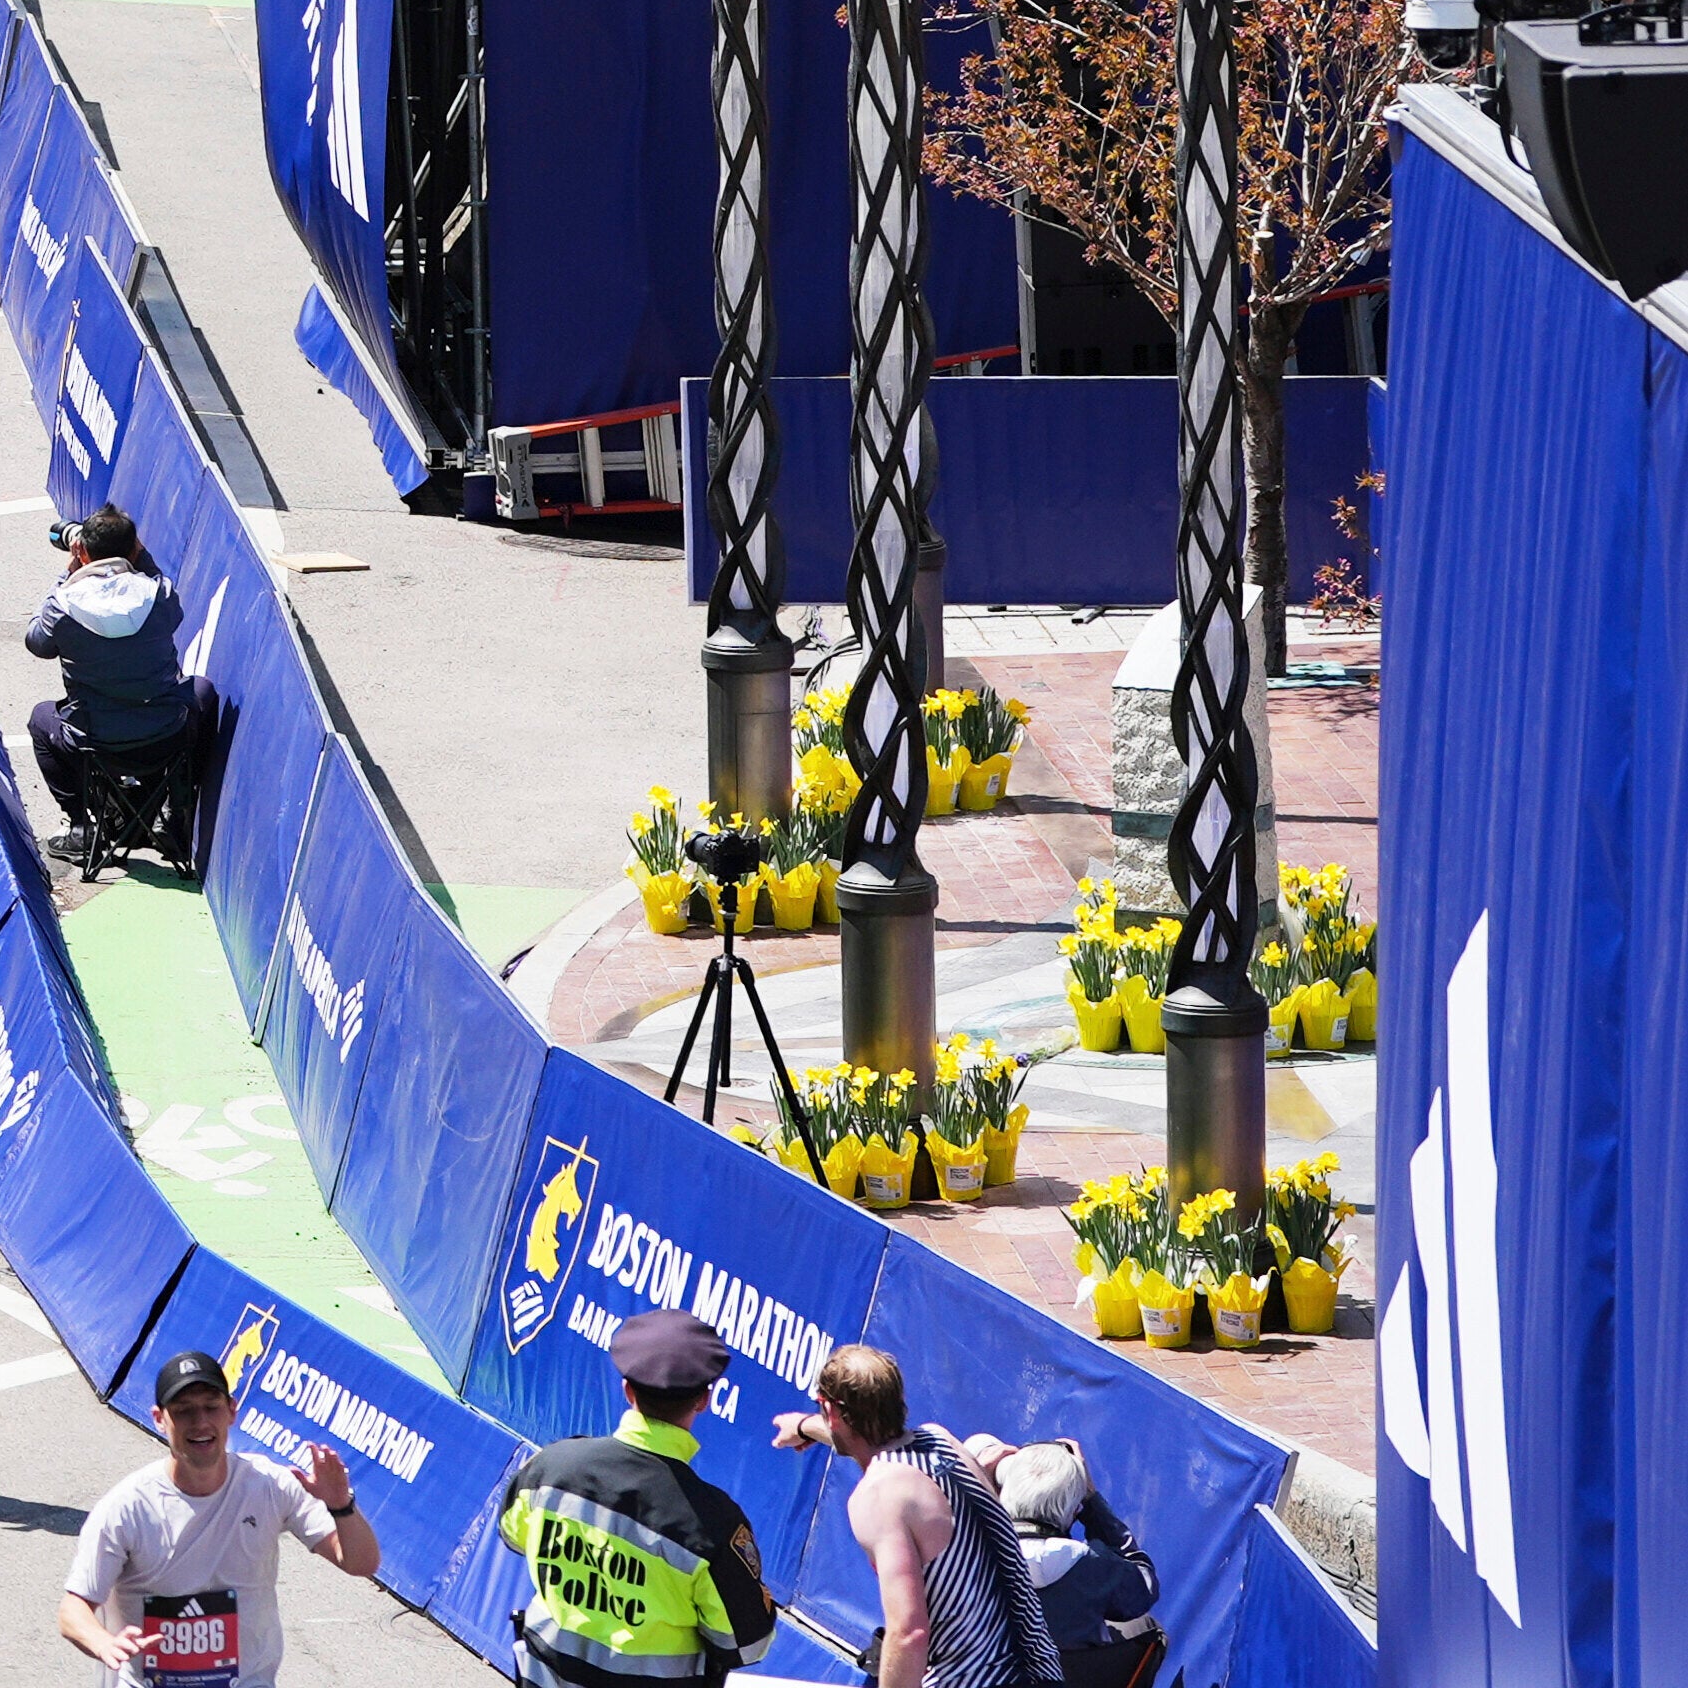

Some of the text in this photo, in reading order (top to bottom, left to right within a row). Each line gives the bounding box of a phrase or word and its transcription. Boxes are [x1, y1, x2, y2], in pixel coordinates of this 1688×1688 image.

[567, 1294, 623, 1353] BANK
[587, 1202, 834, 1404] BOSTON MARATHON
[240, 1407, 279, 1450] BANK
[274, 1428, 298, 1461] OF
[262, 1348, 435, 1483] BOSTON MARATHON
[537, 1518, 647, 1588] Boston
[537, 1563, 647, 1628] Police
[159, 1618, 225, 1656] 3986
